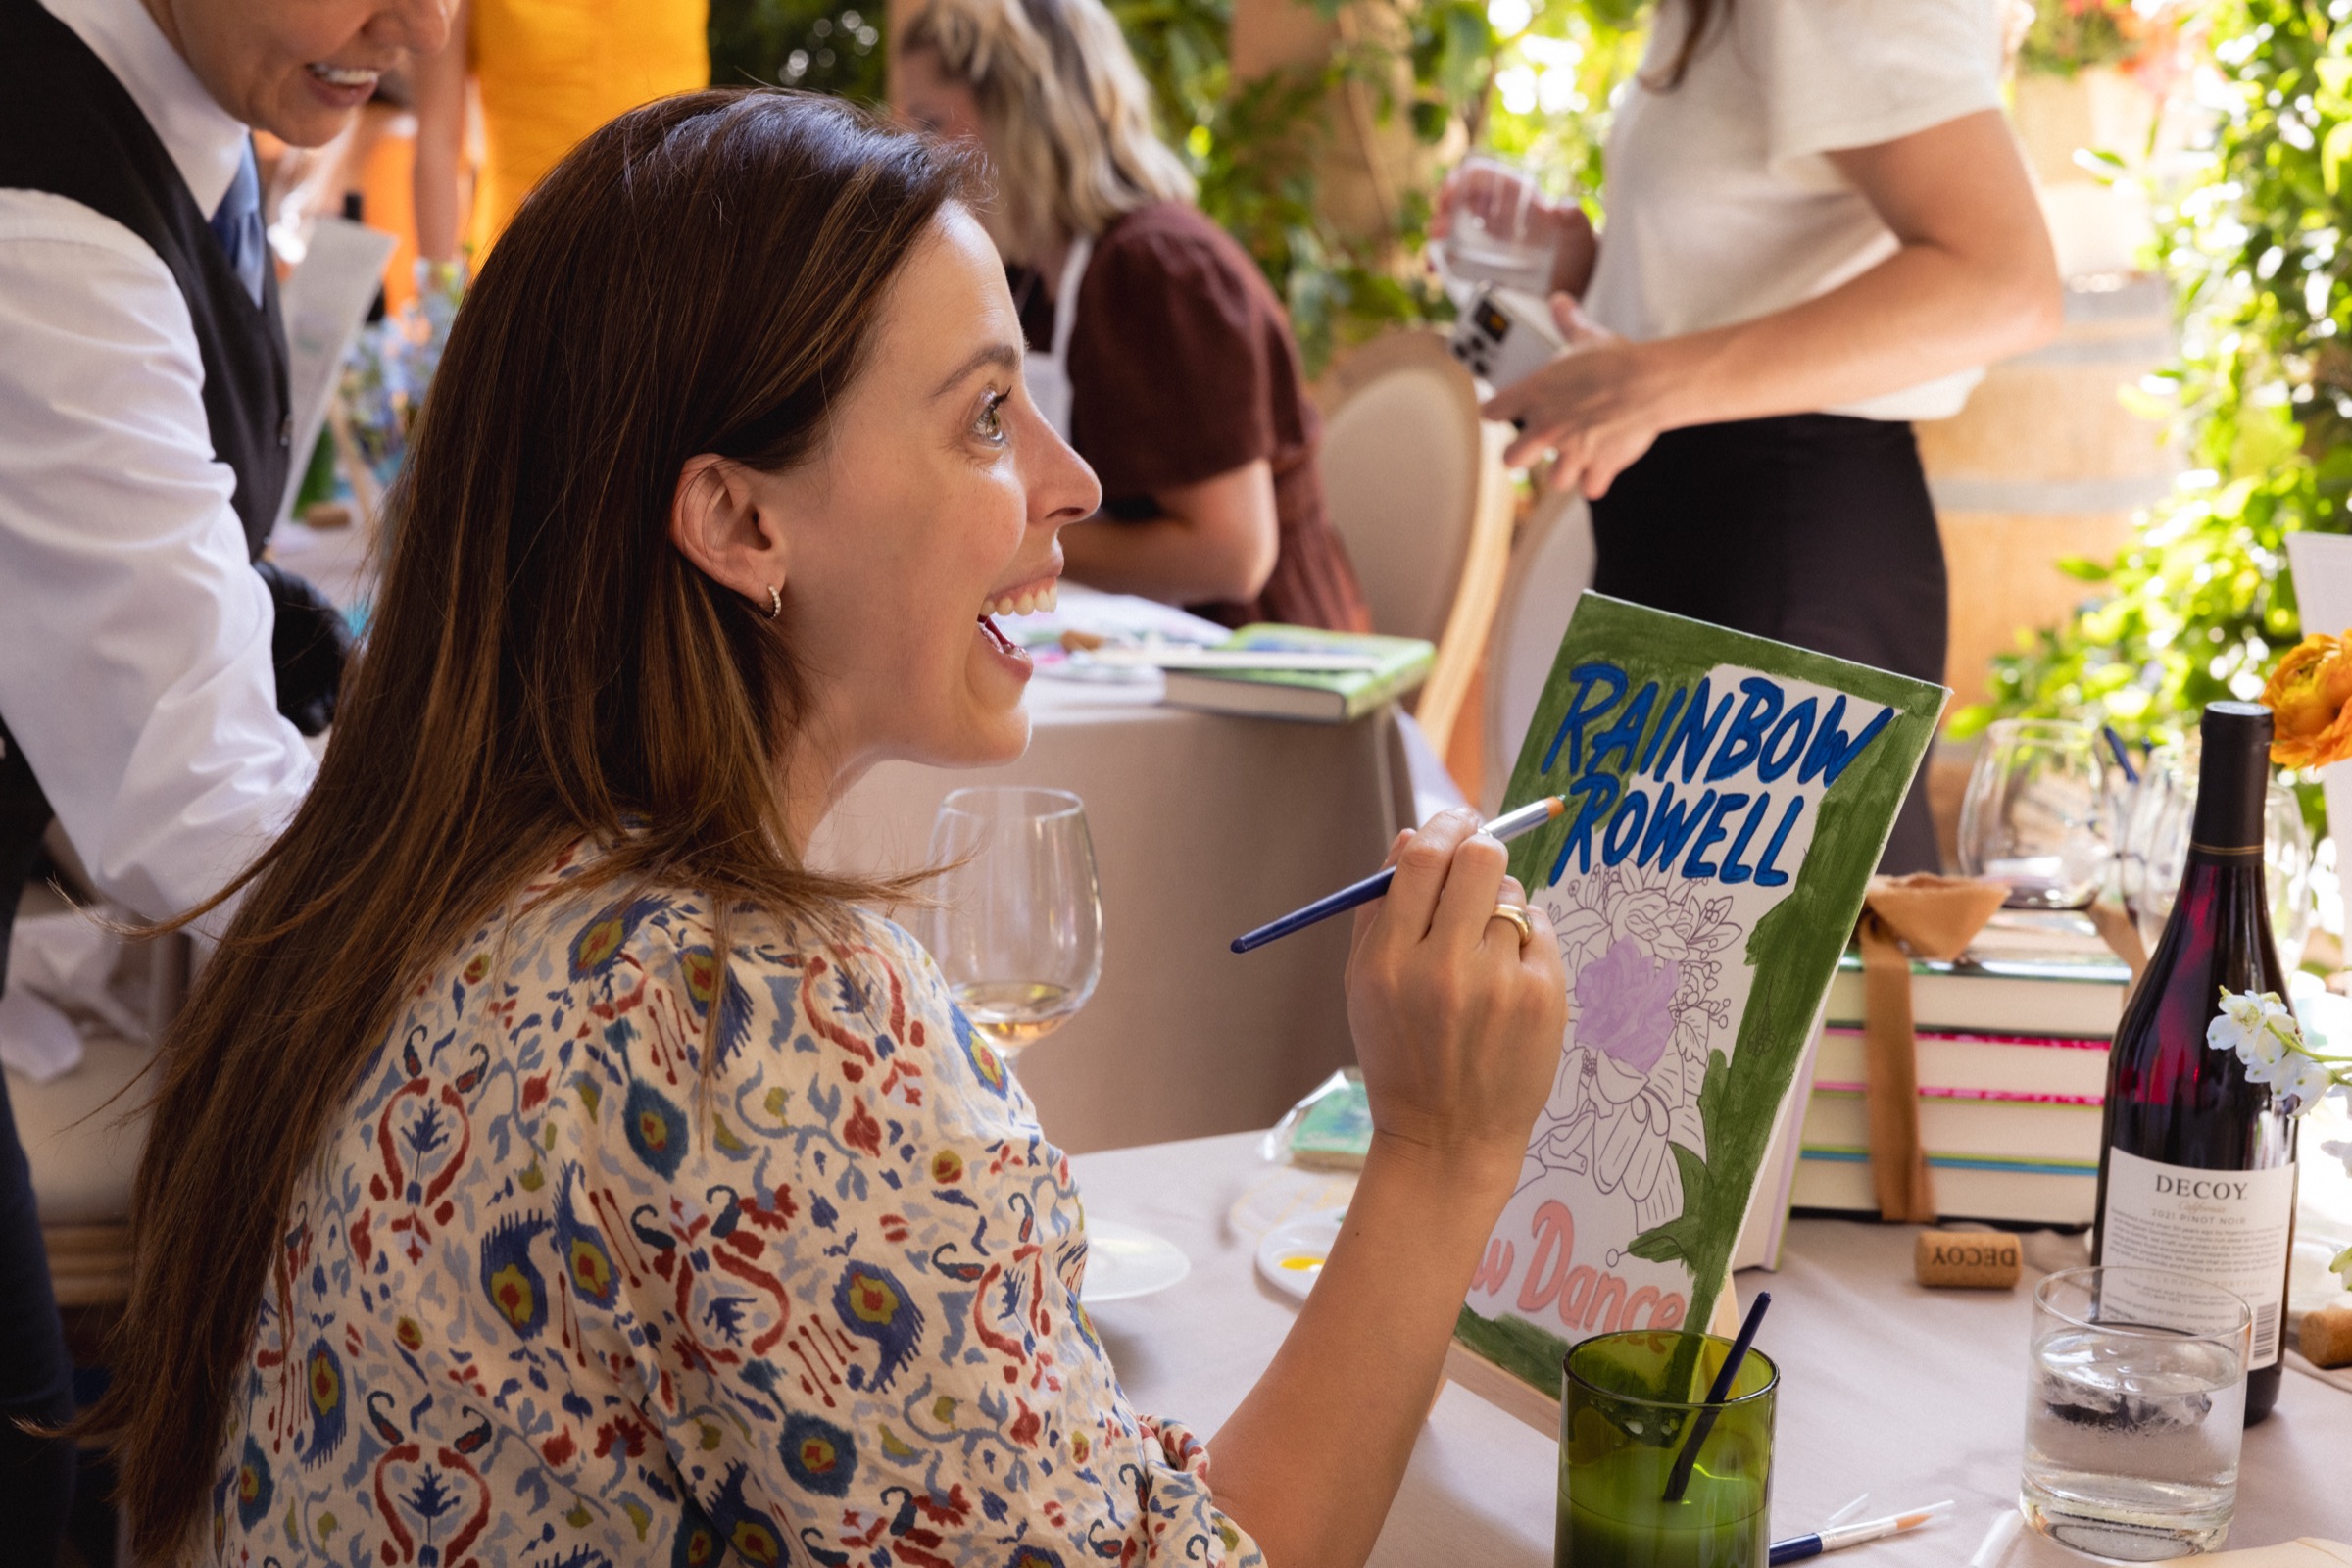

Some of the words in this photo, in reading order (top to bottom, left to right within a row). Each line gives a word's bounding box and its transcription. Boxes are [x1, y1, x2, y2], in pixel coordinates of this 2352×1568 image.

[1541, 662, 1894, 788] RAINBOW
[1548, 773, 1804, 887] ROWELL
[2151, 1208, 2176, 1220] 2021
[2180, 1213, 2215, 1225] PINOT
[2219, 1217, 2246, 1226] NOIR
[2156, 1174, 2248, 1200] DECOY
[1517, 1200, 1686, 1353] Dance
[1932, 1246, 2017, 1268] DECOY
